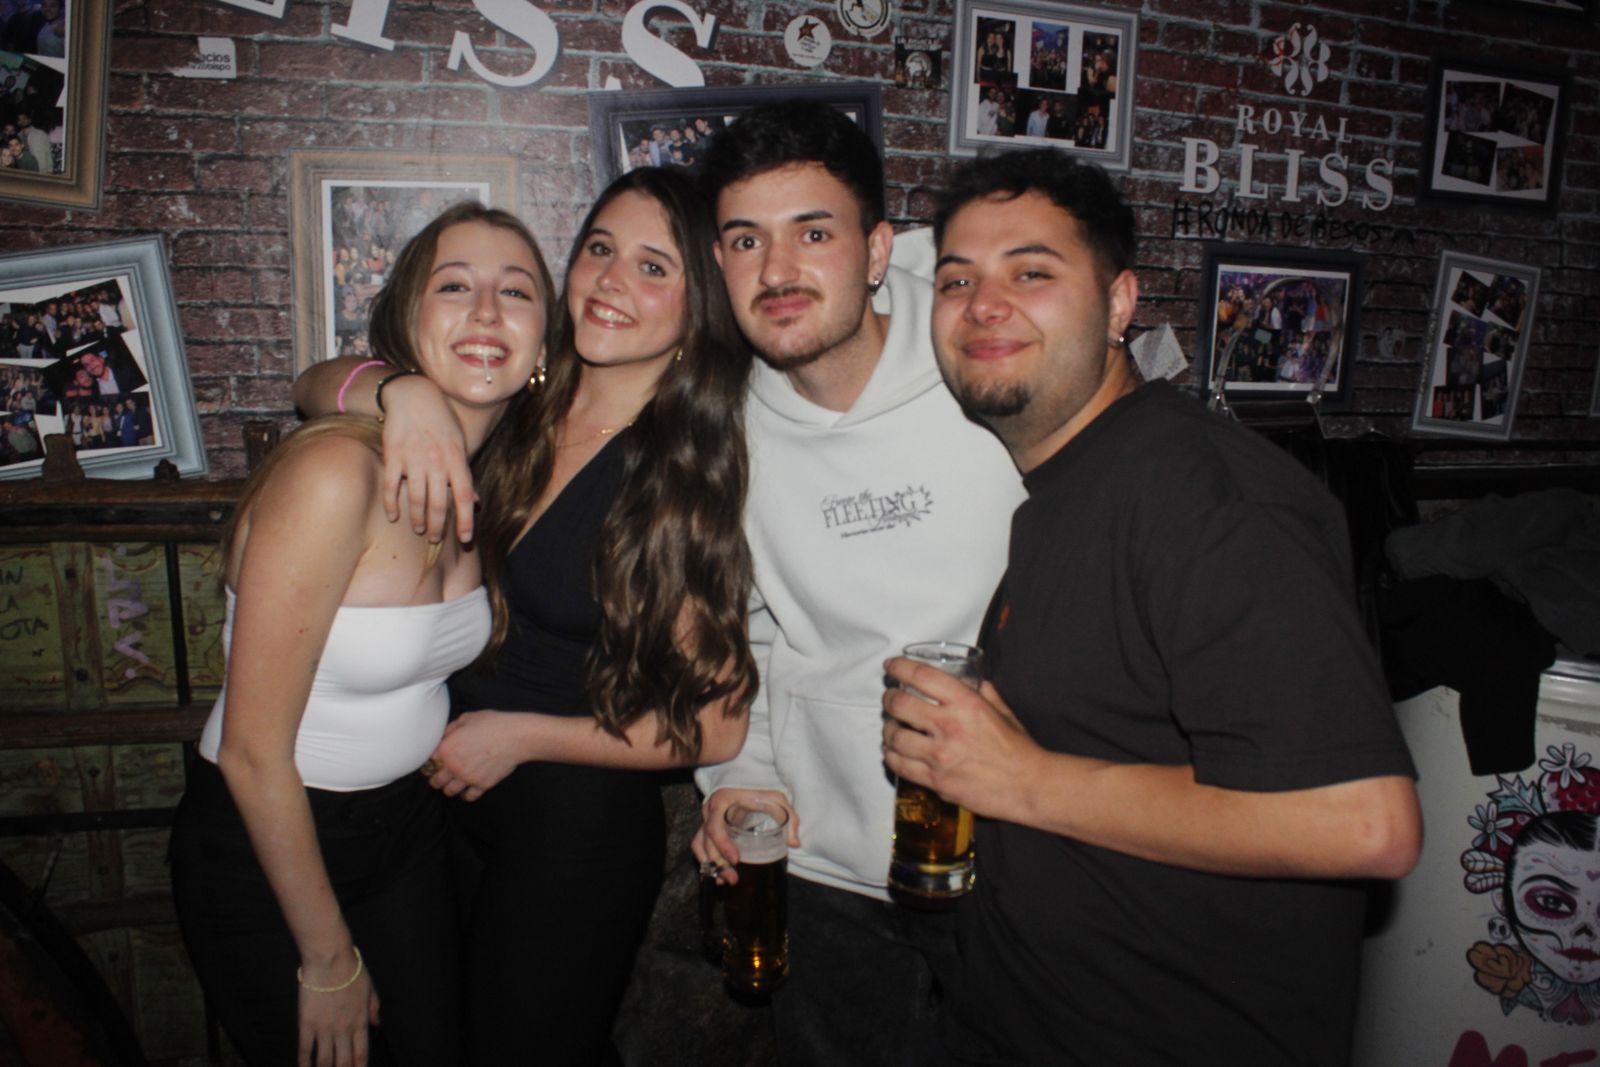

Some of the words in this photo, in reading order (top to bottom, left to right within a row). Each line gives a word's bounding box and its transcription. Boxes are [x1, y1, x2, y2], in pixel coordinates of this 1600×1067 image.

[1237, 104, 1352, 143] ROYAL
[1179, 137, 1394, 211] BLISS
[822, 493, 917, 528] FLEETING
